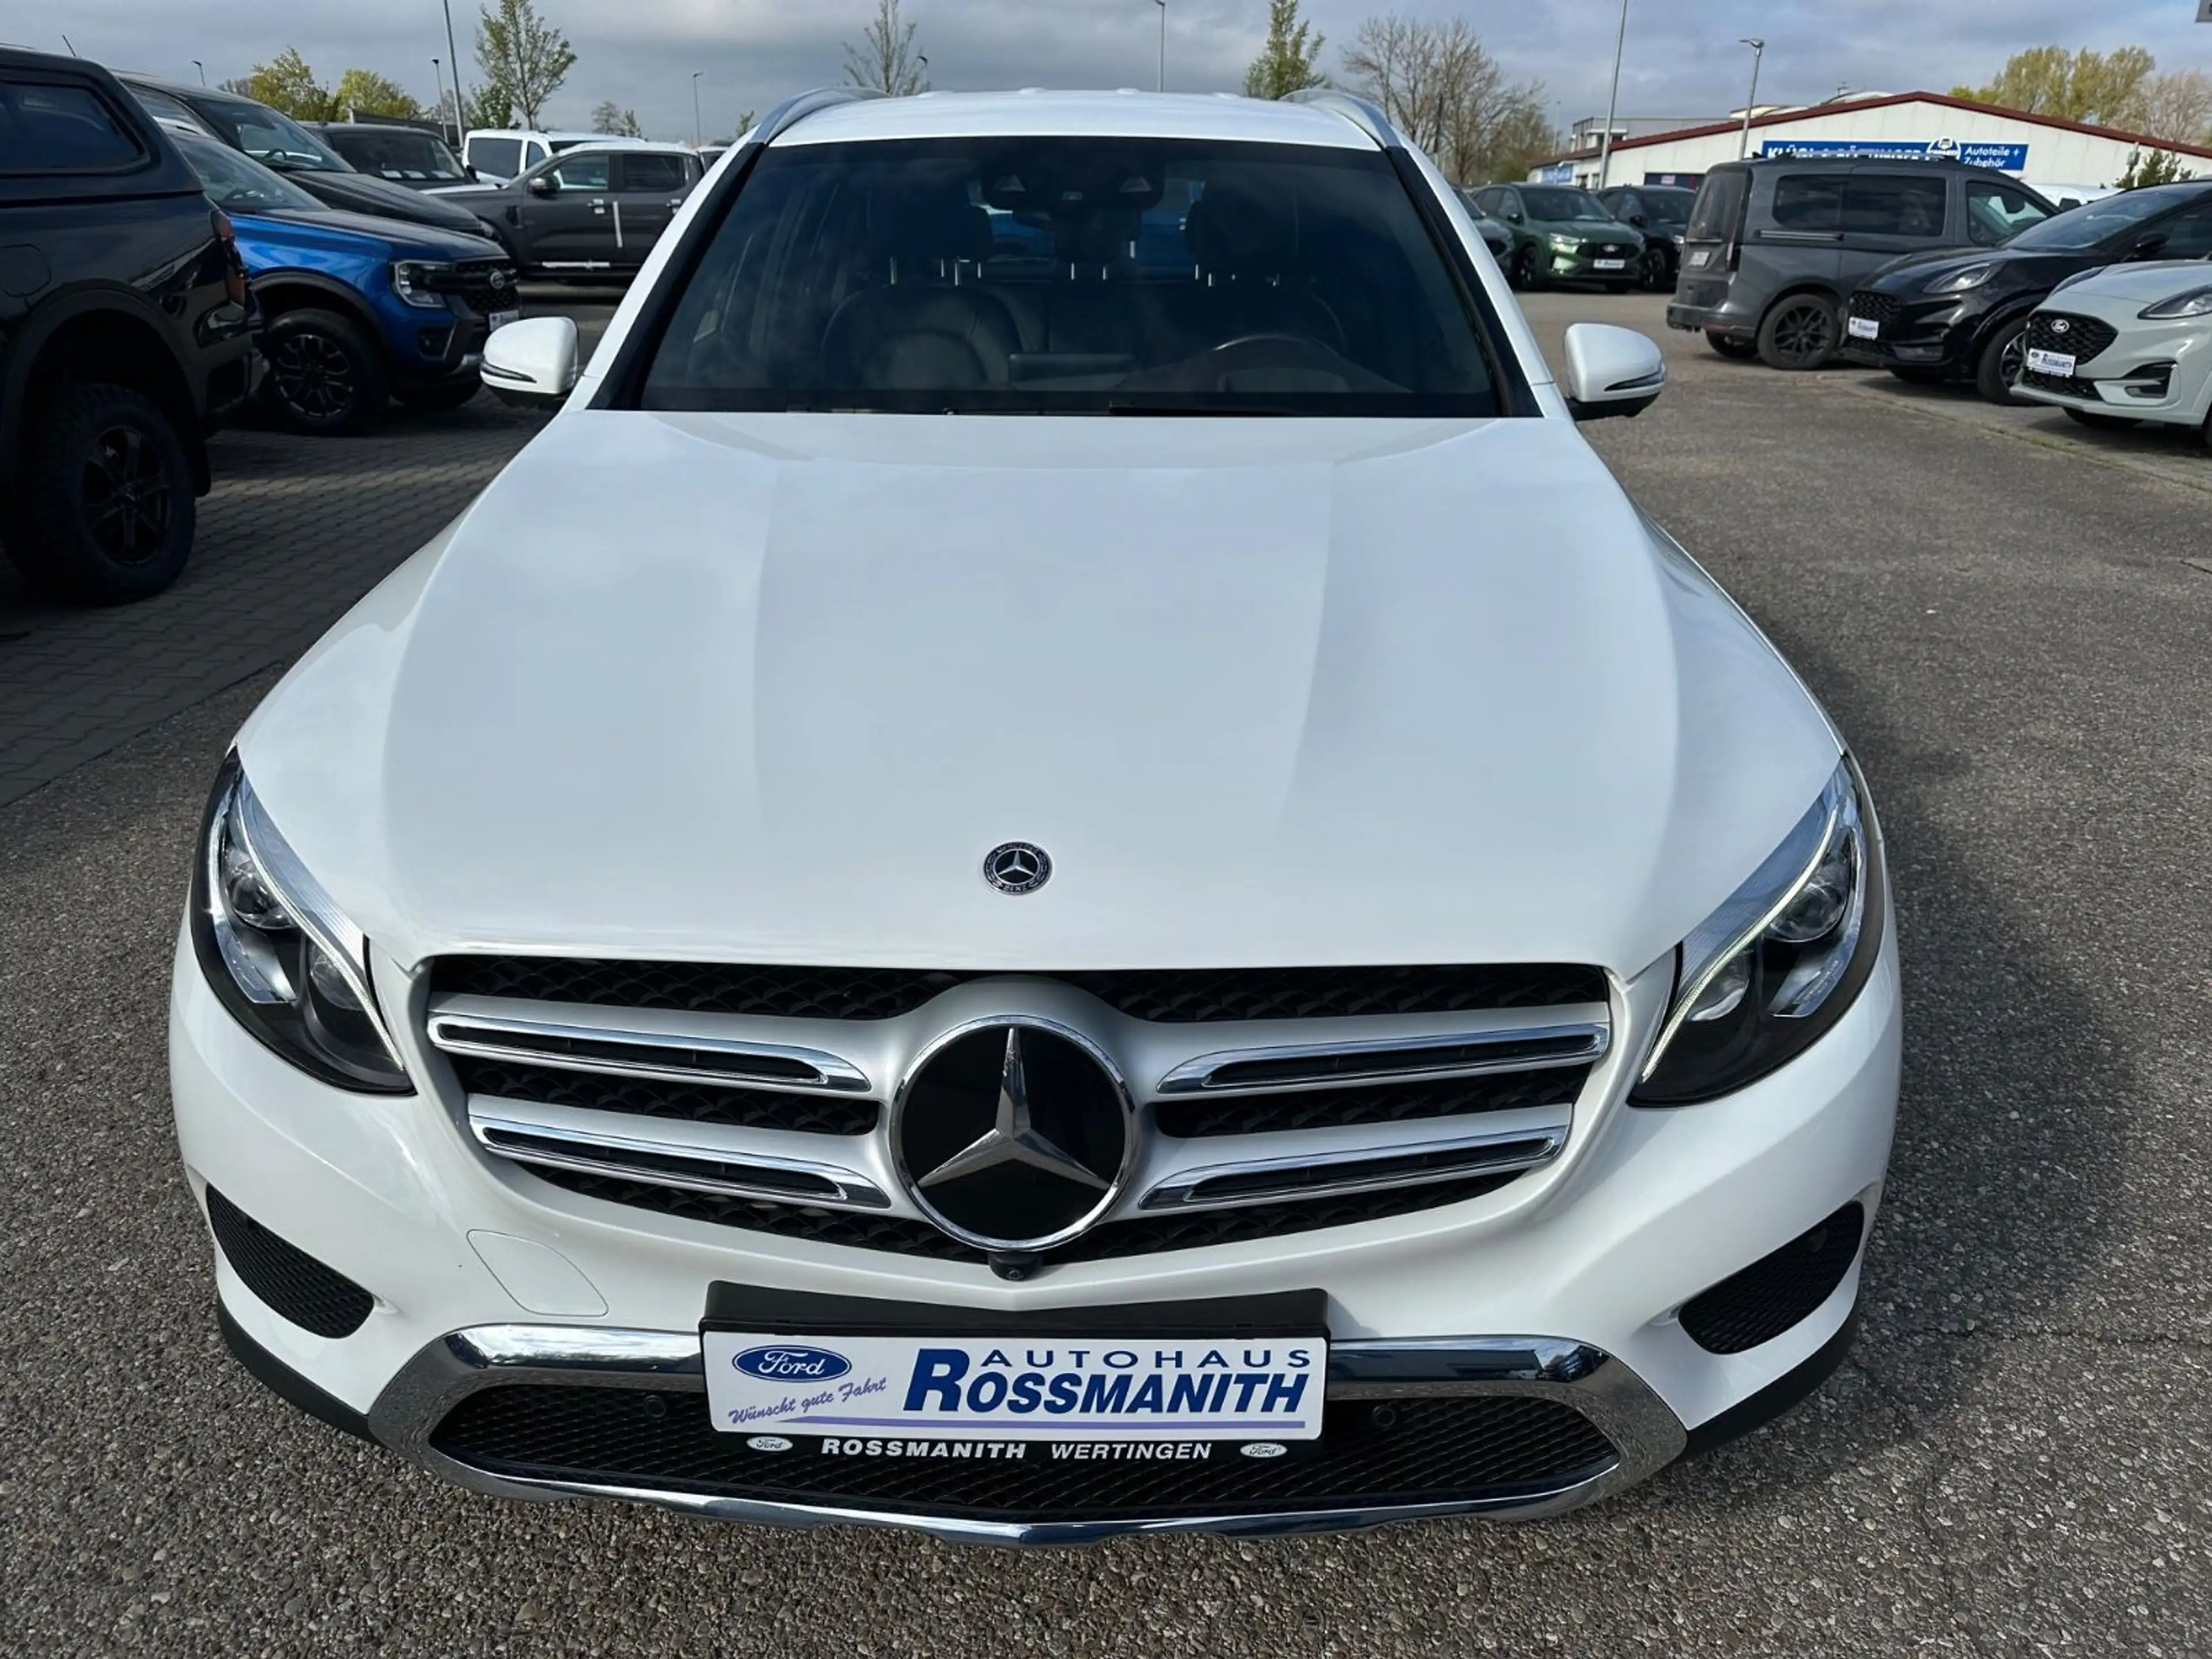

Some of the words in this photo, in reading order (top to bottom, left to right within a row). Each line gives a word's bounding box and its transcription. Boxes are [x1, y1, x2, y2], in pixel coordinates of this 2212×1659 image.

[1964, 146, 2010, 156] Autoteile
[757, 1350, 826, 1375] Ford
[980, 1349, 1310, 1369] AUTOHAUS
[902, 1348, 1310, 1414] ROSSMANITH
[728, 1396, 796, 1424] Wünscht
[801, 1391, 834, 1412] gute
[838, 1376, 887, 1402] Fahrt
[821, 1438, 1027, 1459] ROSSMANITH
[1051, 1442, 1212, 1460] WERTINGEN
